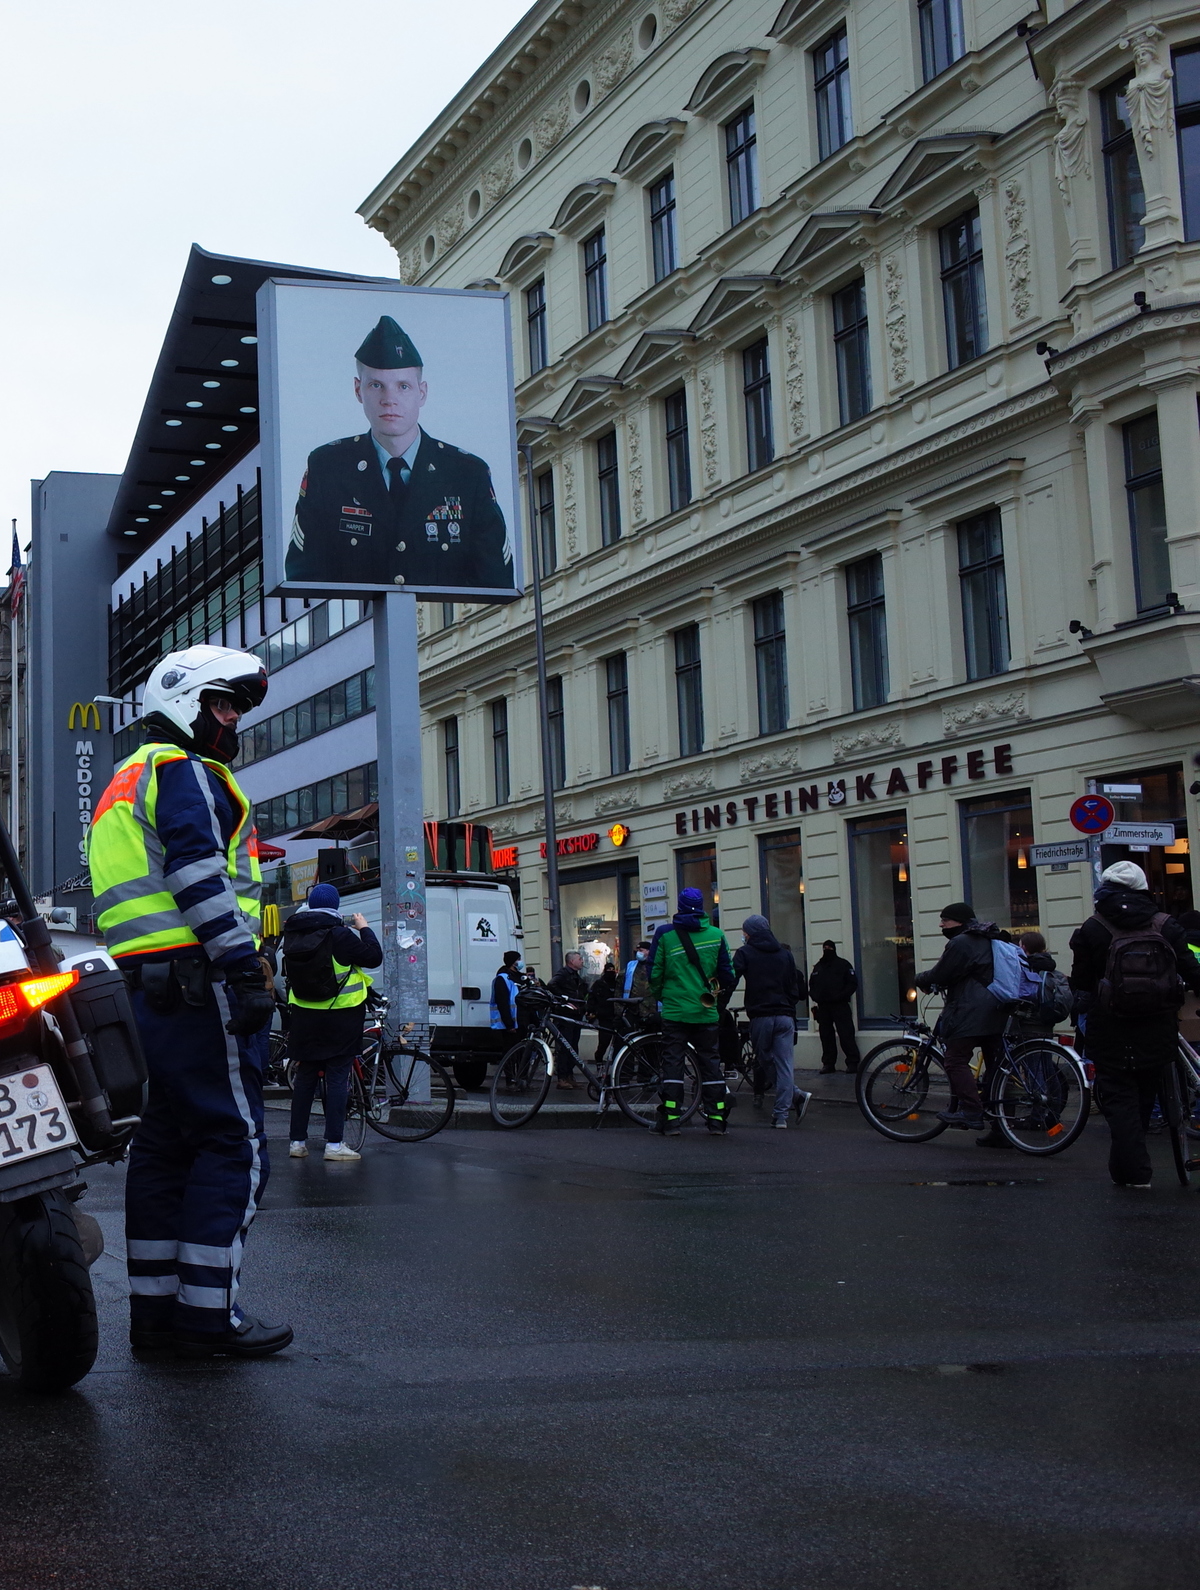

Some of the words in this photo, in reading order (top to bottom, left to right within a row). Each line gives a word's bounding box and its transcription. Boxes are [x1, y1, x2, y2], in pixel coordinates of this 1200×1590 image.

[676, 784, 818, 835] EINSTEIN
[856, 744, 1014, 800] KAFFEE
[568, 831, 597, 854] SHOP
[1114, 827, 1164, 841] Zimmerstraße
[1035, 844, 1084, 859] Friedrichstraße
